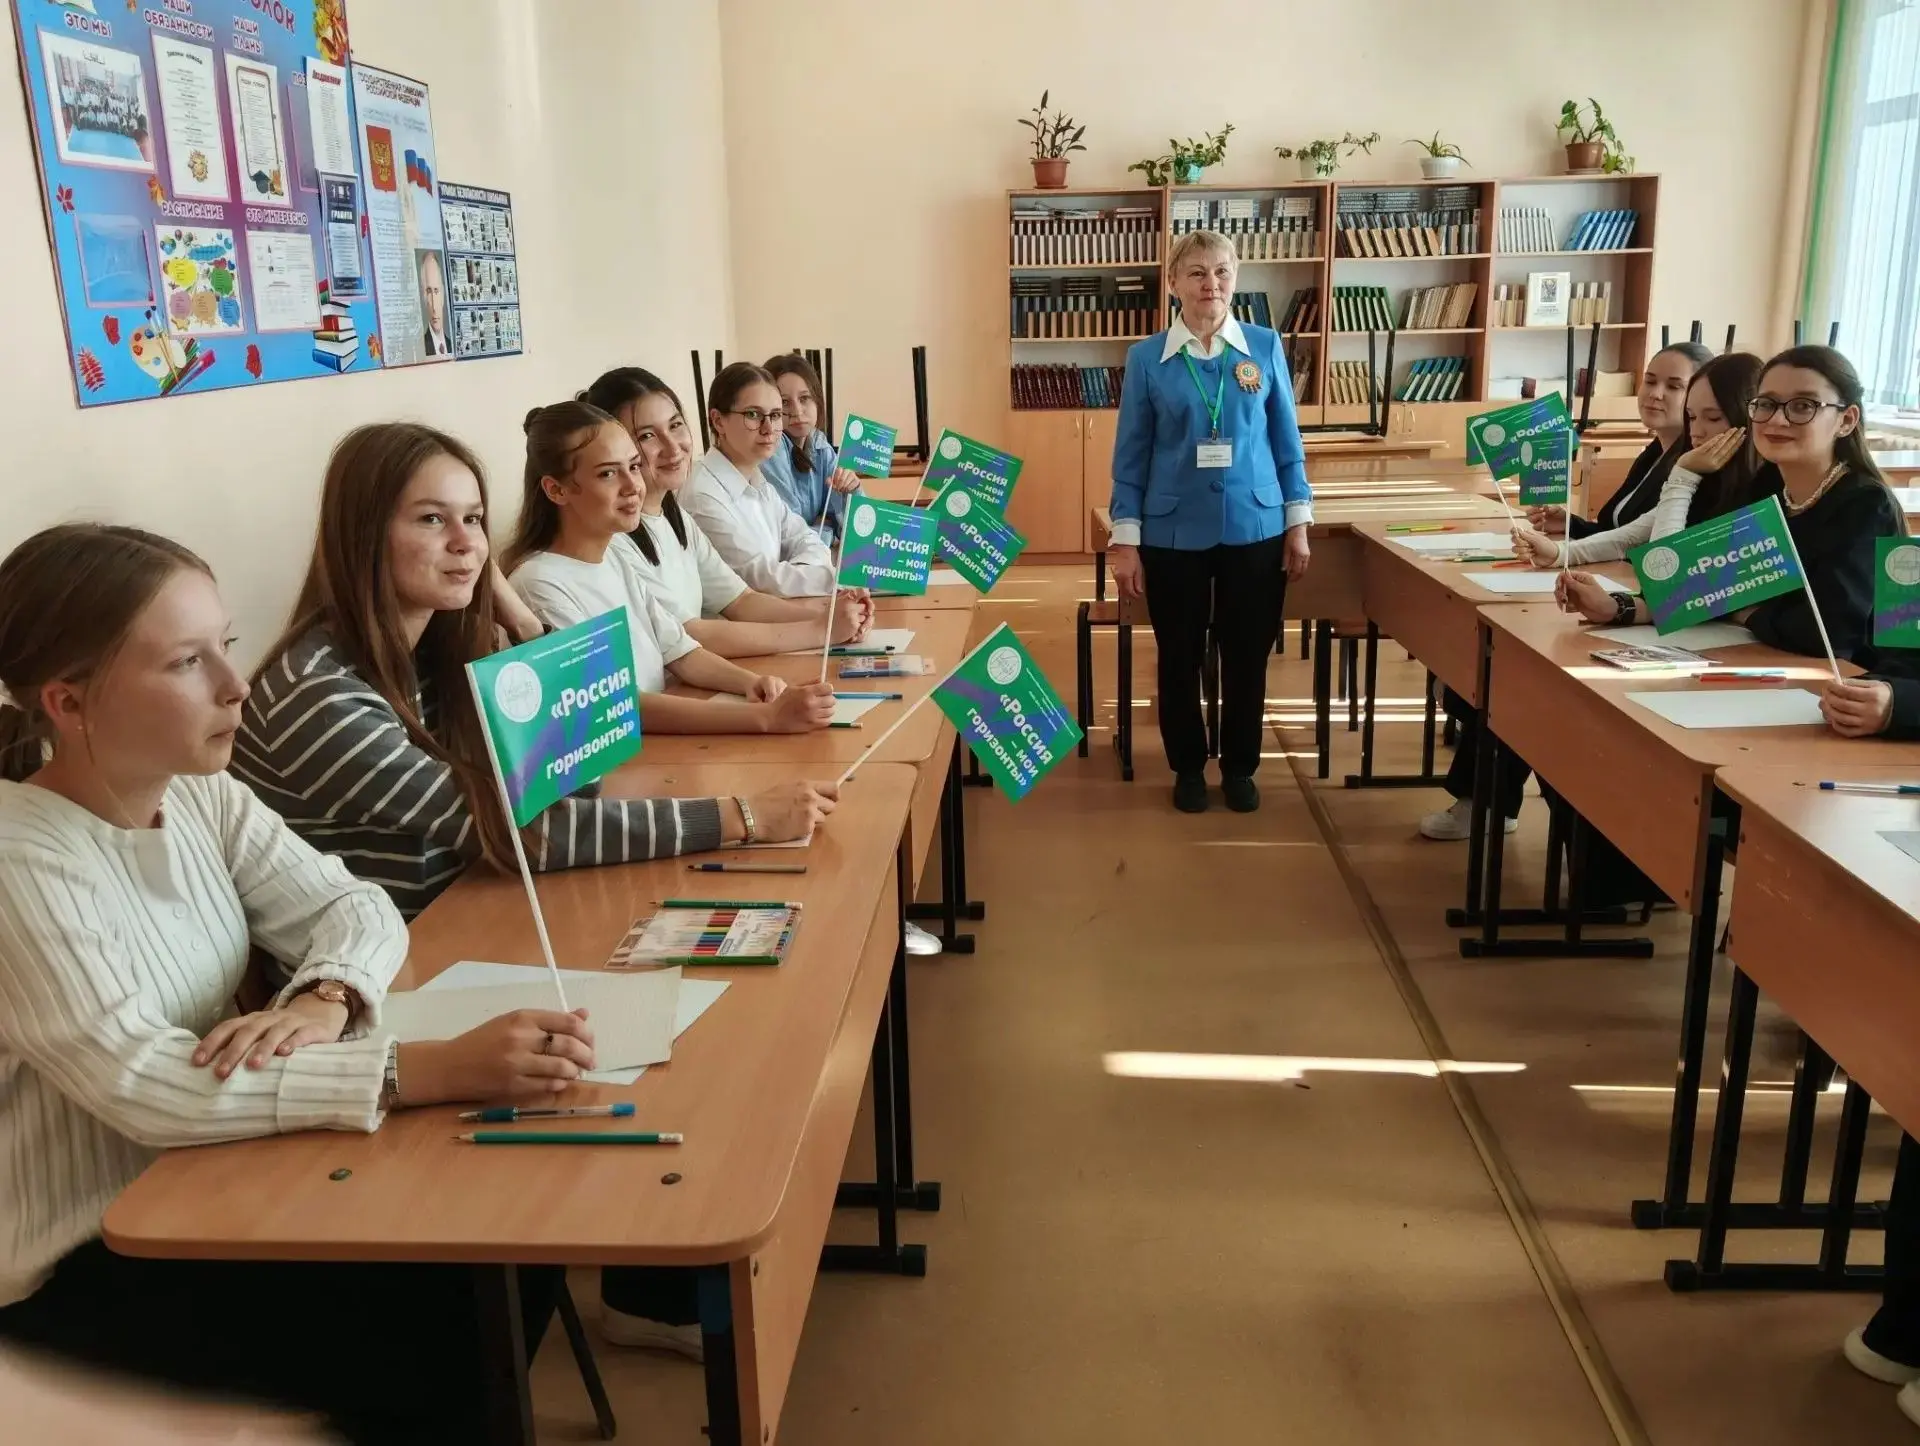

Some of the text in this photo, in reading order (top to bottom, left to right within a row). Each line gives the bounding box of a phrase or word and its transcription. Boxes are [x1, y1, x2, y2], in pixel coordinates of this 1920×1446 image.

[65, 11, 112, 38] ЭТО МЫ
[144, 10, 215, 42] ОБЯЗАННОСТИ
[233, 16, 259, 36] НАШИ
[161, 200, 224, 220] РАСПИСАНИЕ
[246, 207, 308, 225] ЭТО ИНТЕРЕСНО
[1687, 535, 1778, 577] «Россия
[1750, 553, 1785, 573] мои
[1685, 568, 1788, 611] горизонты»
[551, 666, 631, 720] «Россия
[606, 696, 634, 722] мои
[546, 719, 635, 780] горизонты»
